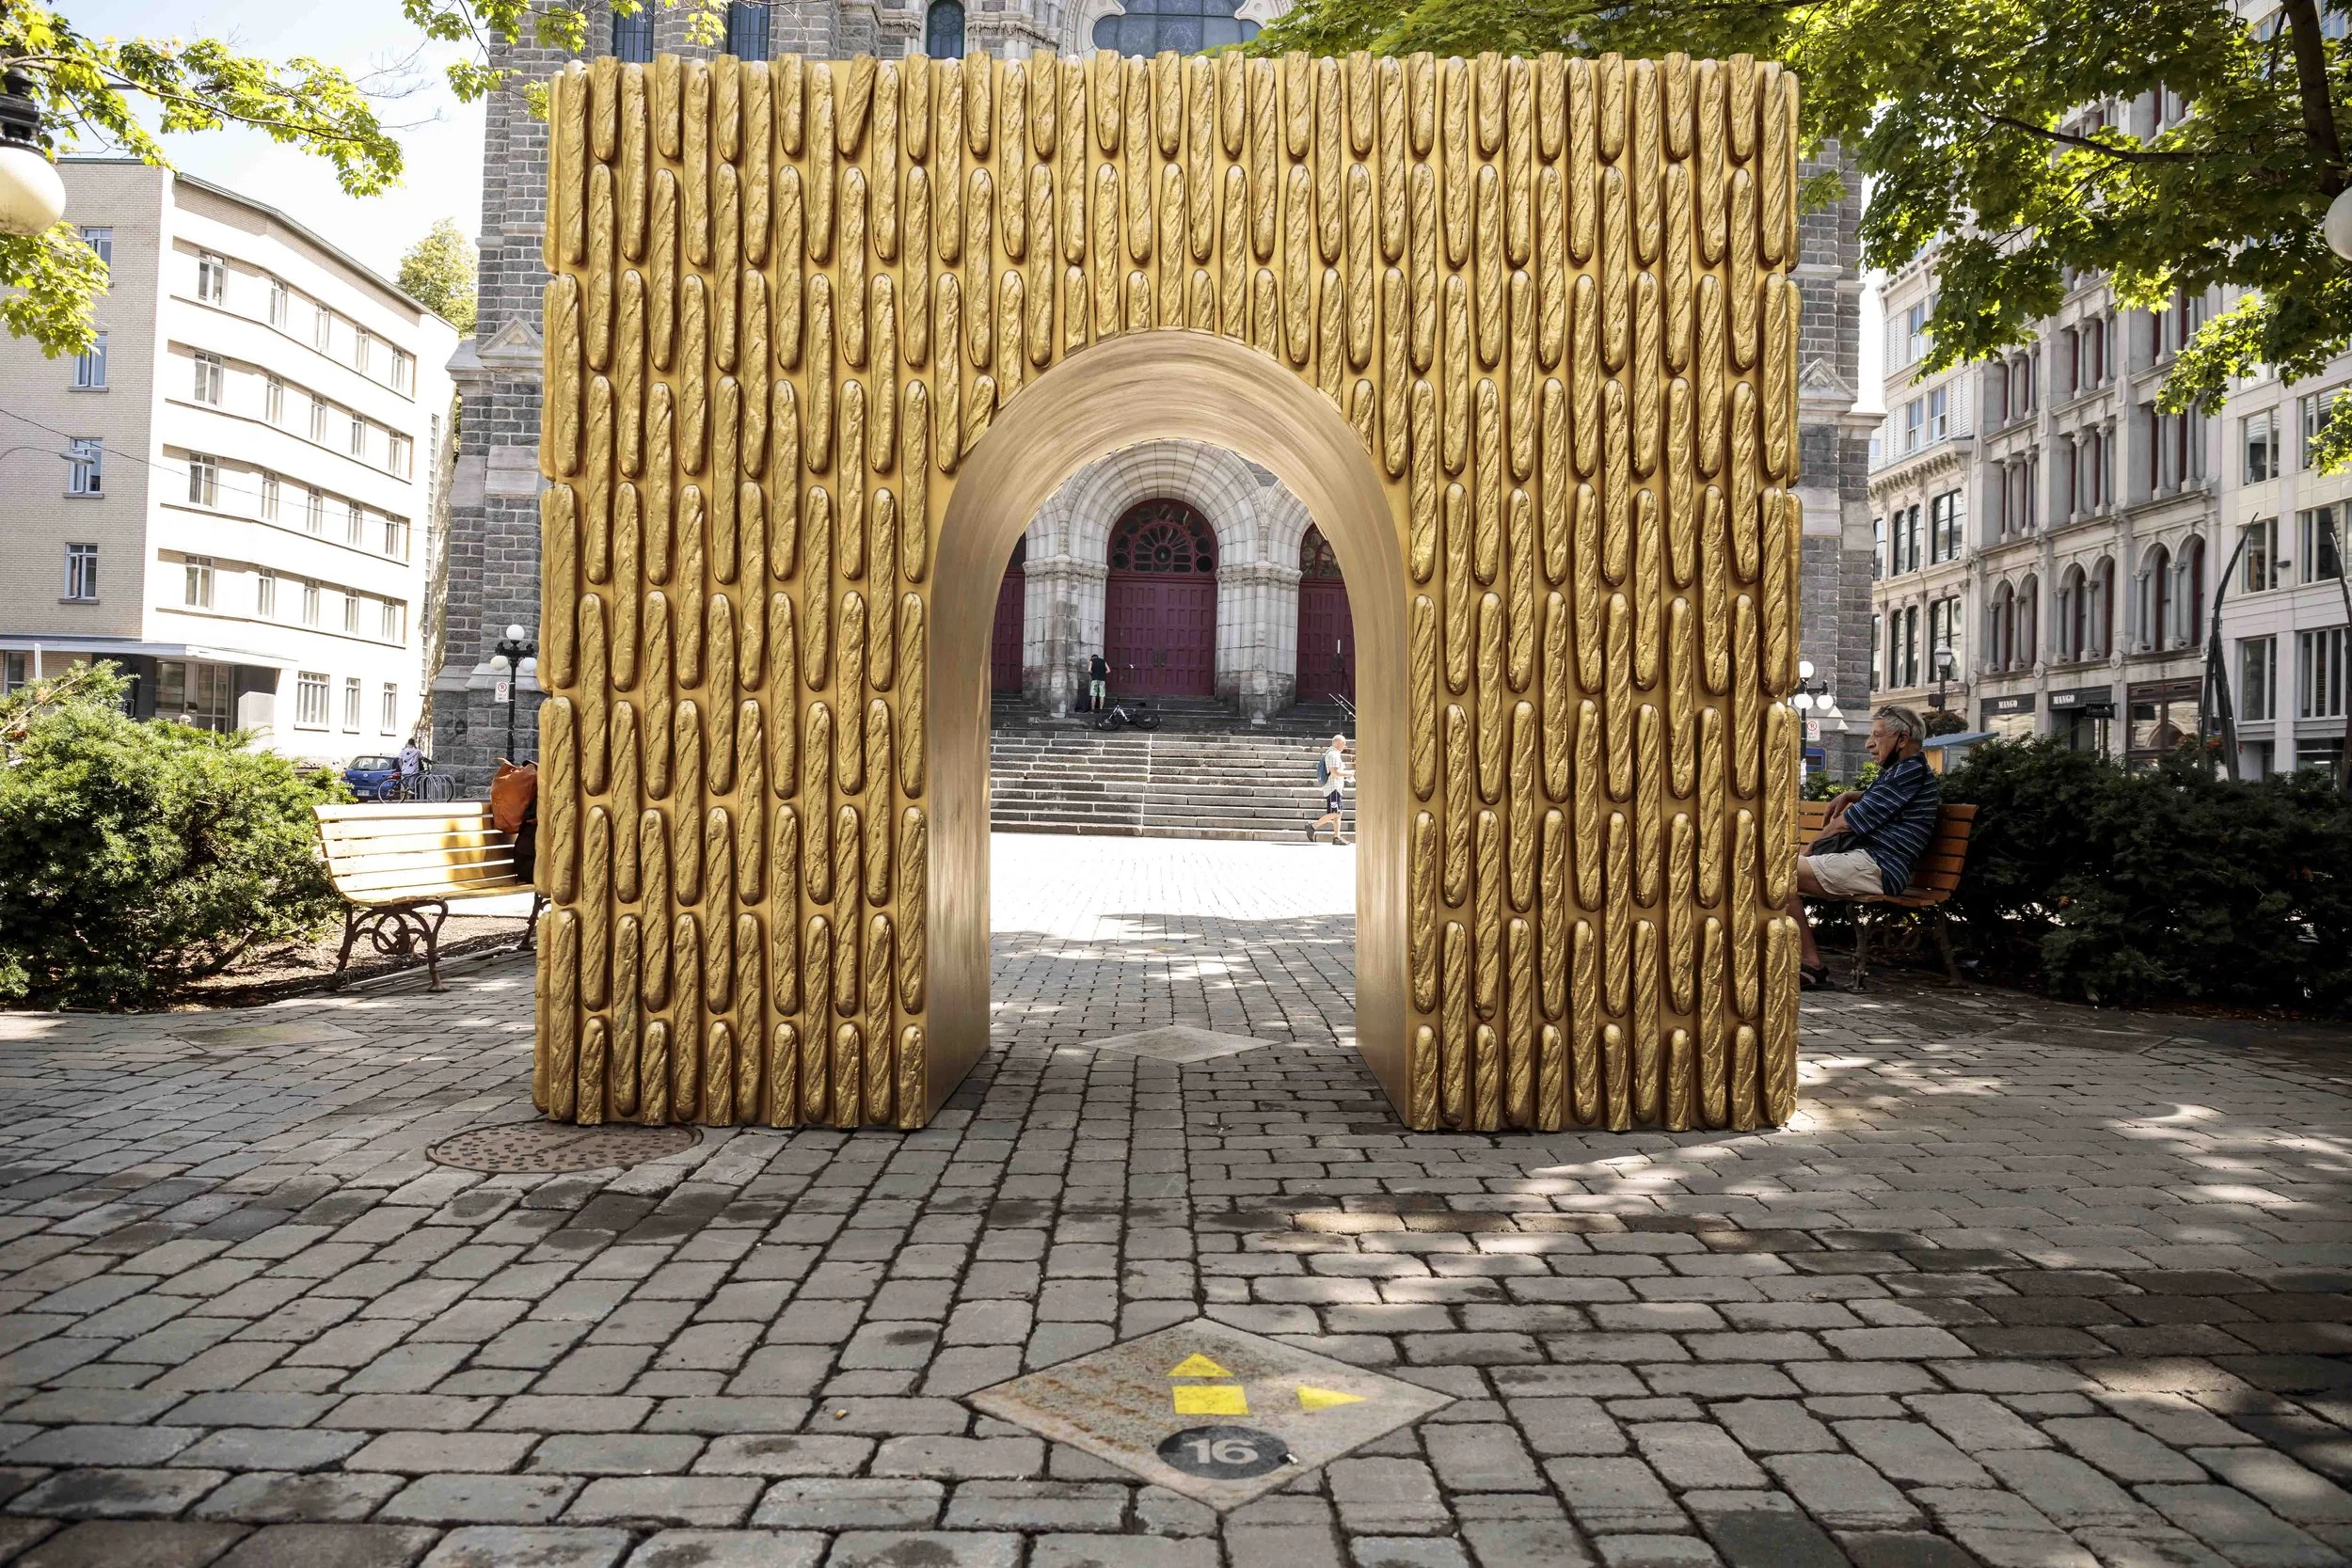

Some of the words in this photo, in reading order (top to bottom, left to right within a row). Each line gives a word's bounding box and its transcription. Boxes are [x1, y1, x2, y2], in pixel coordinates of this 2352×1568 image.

[1998, 700, 2018, 709] MANGO
[2053, 694, 2074, 705] MANGO
[1183, 1438, 1259, 1465] 16
